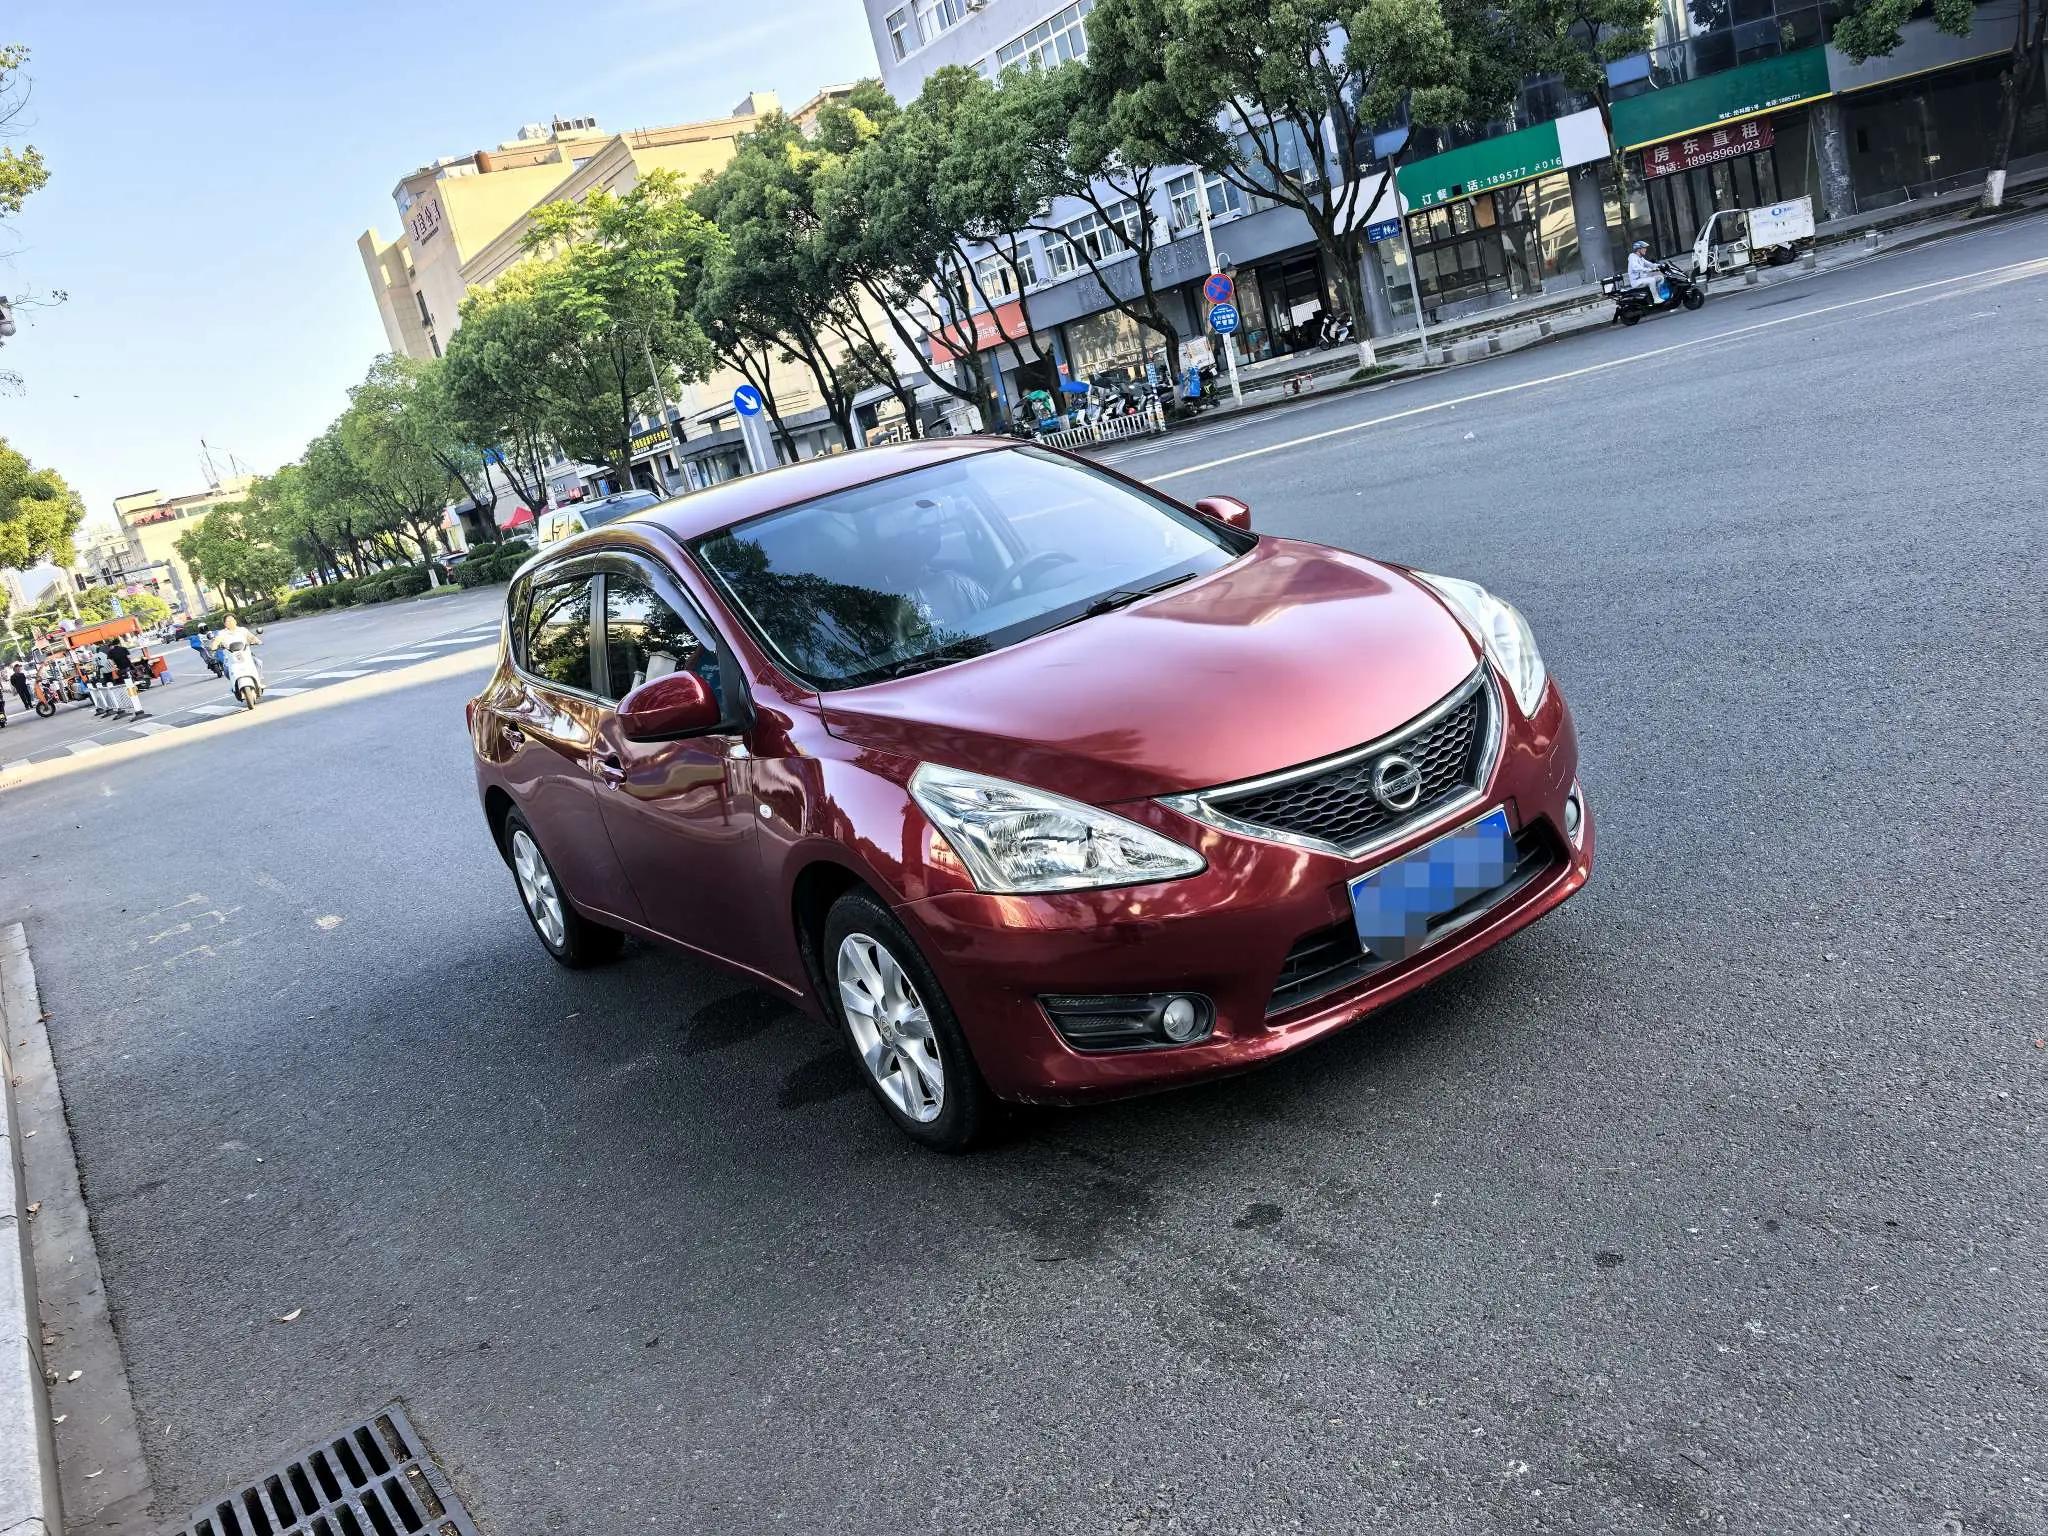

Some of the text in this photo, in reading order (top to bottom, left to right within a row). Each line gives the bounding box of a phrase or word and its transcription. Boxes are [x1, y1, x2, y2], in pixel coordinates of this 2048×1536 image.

[1654, 121, 1760, 164] 房东直租
[1686, 139, 1761, 167] 18958960123
[1381, 773, 1420, 796] NISSAN
